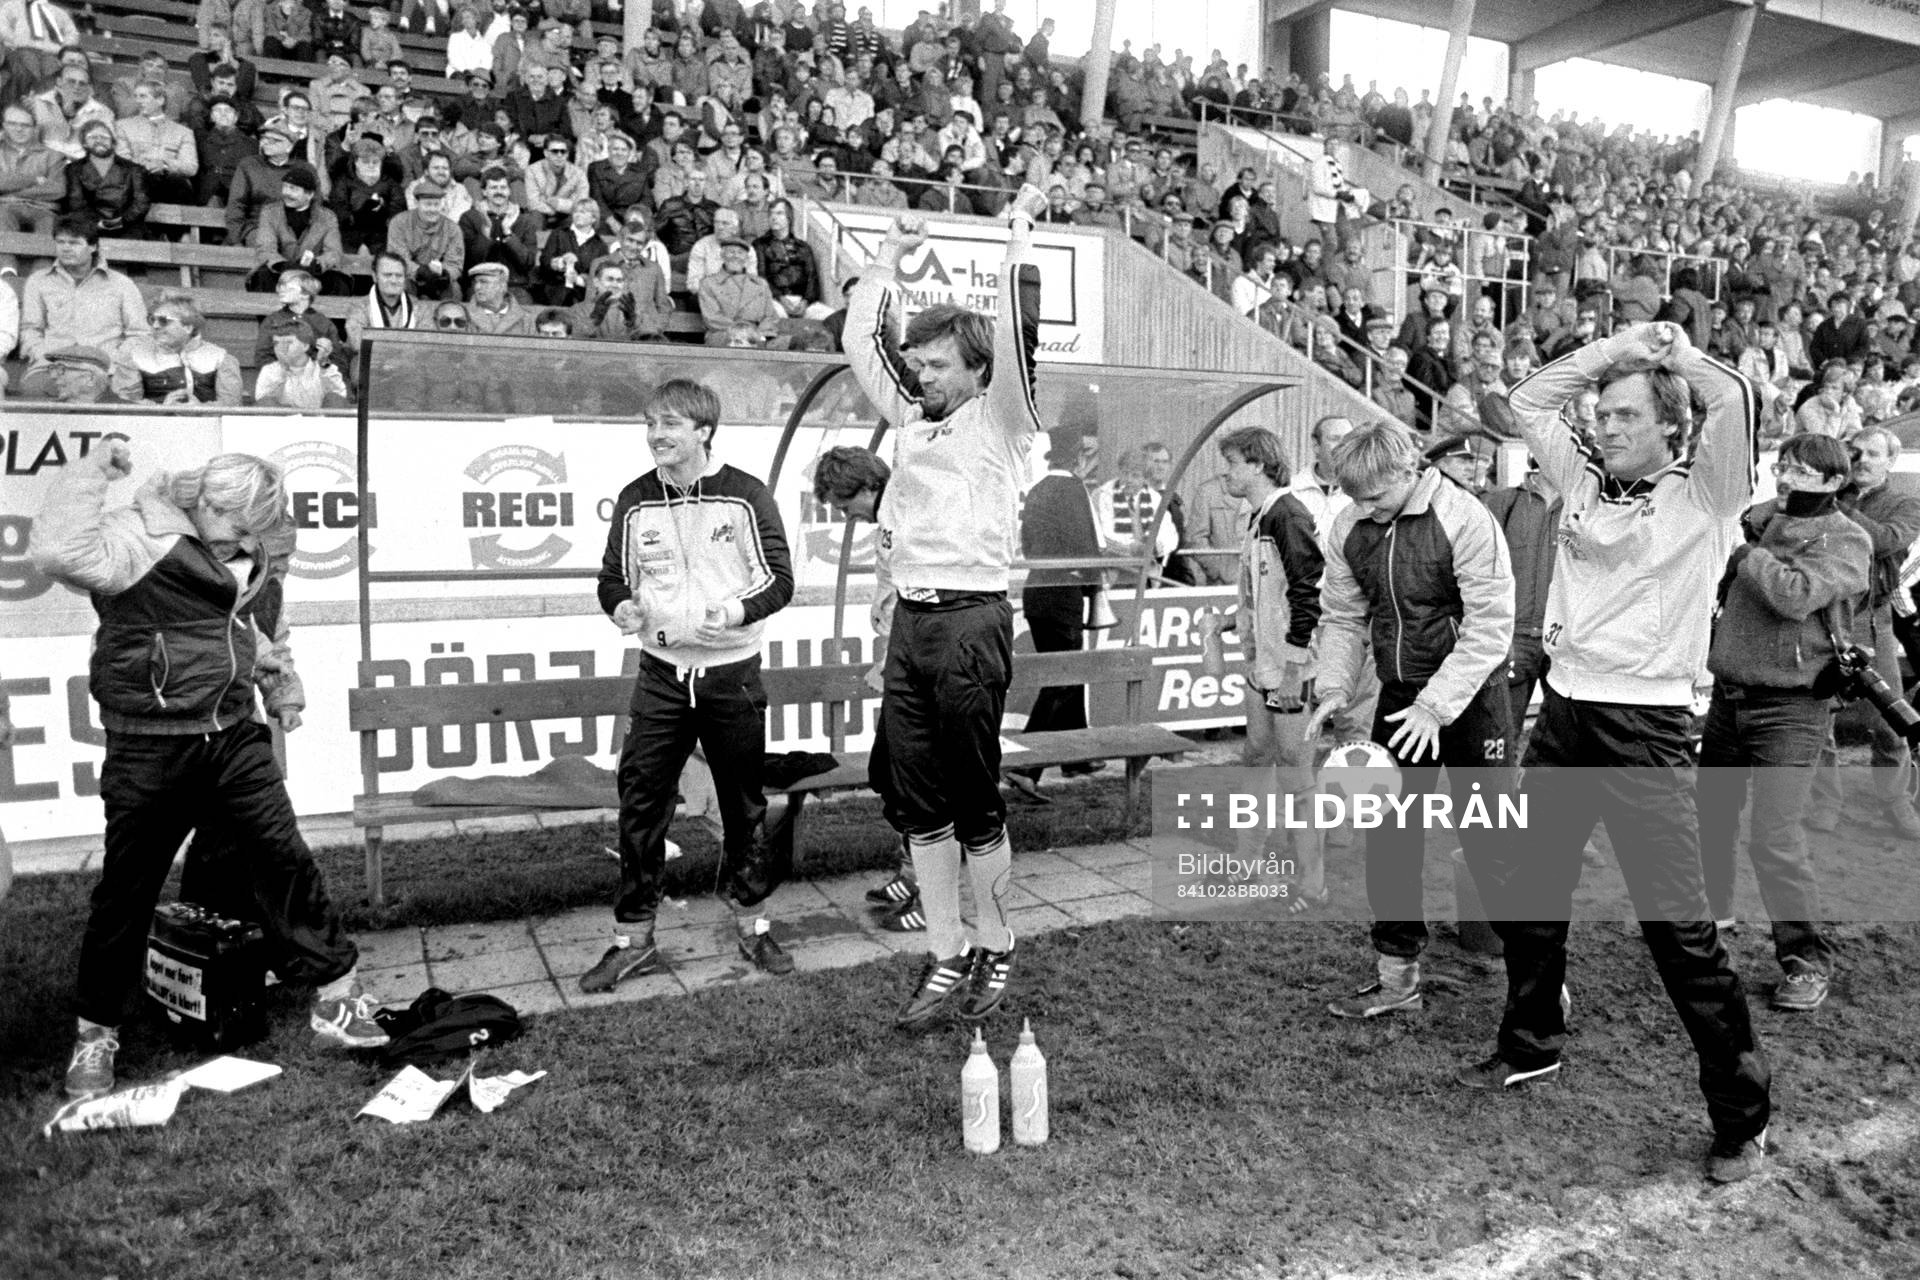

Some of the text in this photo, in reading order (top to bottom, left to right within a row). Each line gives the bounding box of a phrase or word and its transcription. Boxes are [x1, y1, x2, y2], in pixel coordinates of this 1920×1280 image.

[291, 491, 378, 529] ECI
[462, 491, 574, 528] RECI
[657, 630, 668, 648] 9
[1157, 668, 1246, 712] Res
